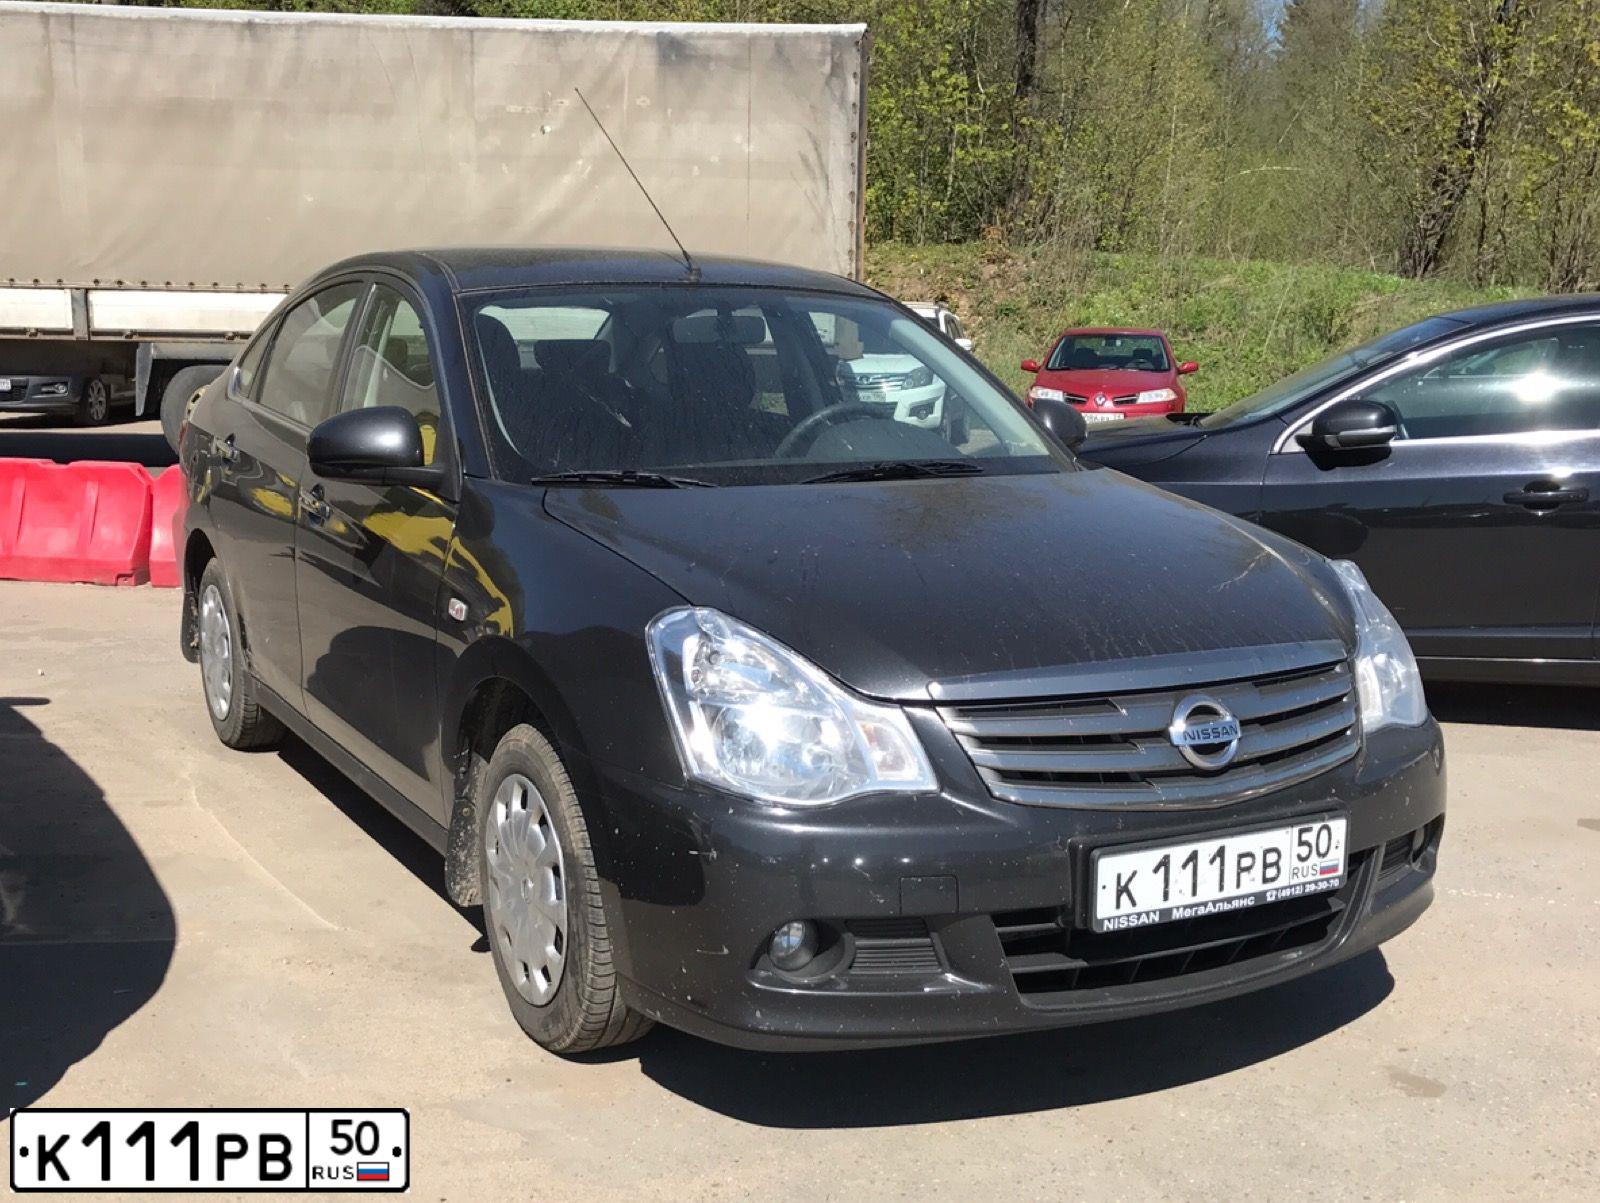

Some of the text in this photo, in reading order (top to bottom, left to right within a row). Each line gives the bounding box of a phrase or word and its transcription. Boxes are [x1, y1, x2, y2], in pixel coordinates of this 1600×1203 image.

[1183, 725, 1238, 741] NISSAN
[1296, 823, 1333, 863] 50
[1291, 863, 1318, 880] RUS
[1103, 911, 1160, 931] NISSAN
[1172, 896, 1255, 920] МегаАльянс
